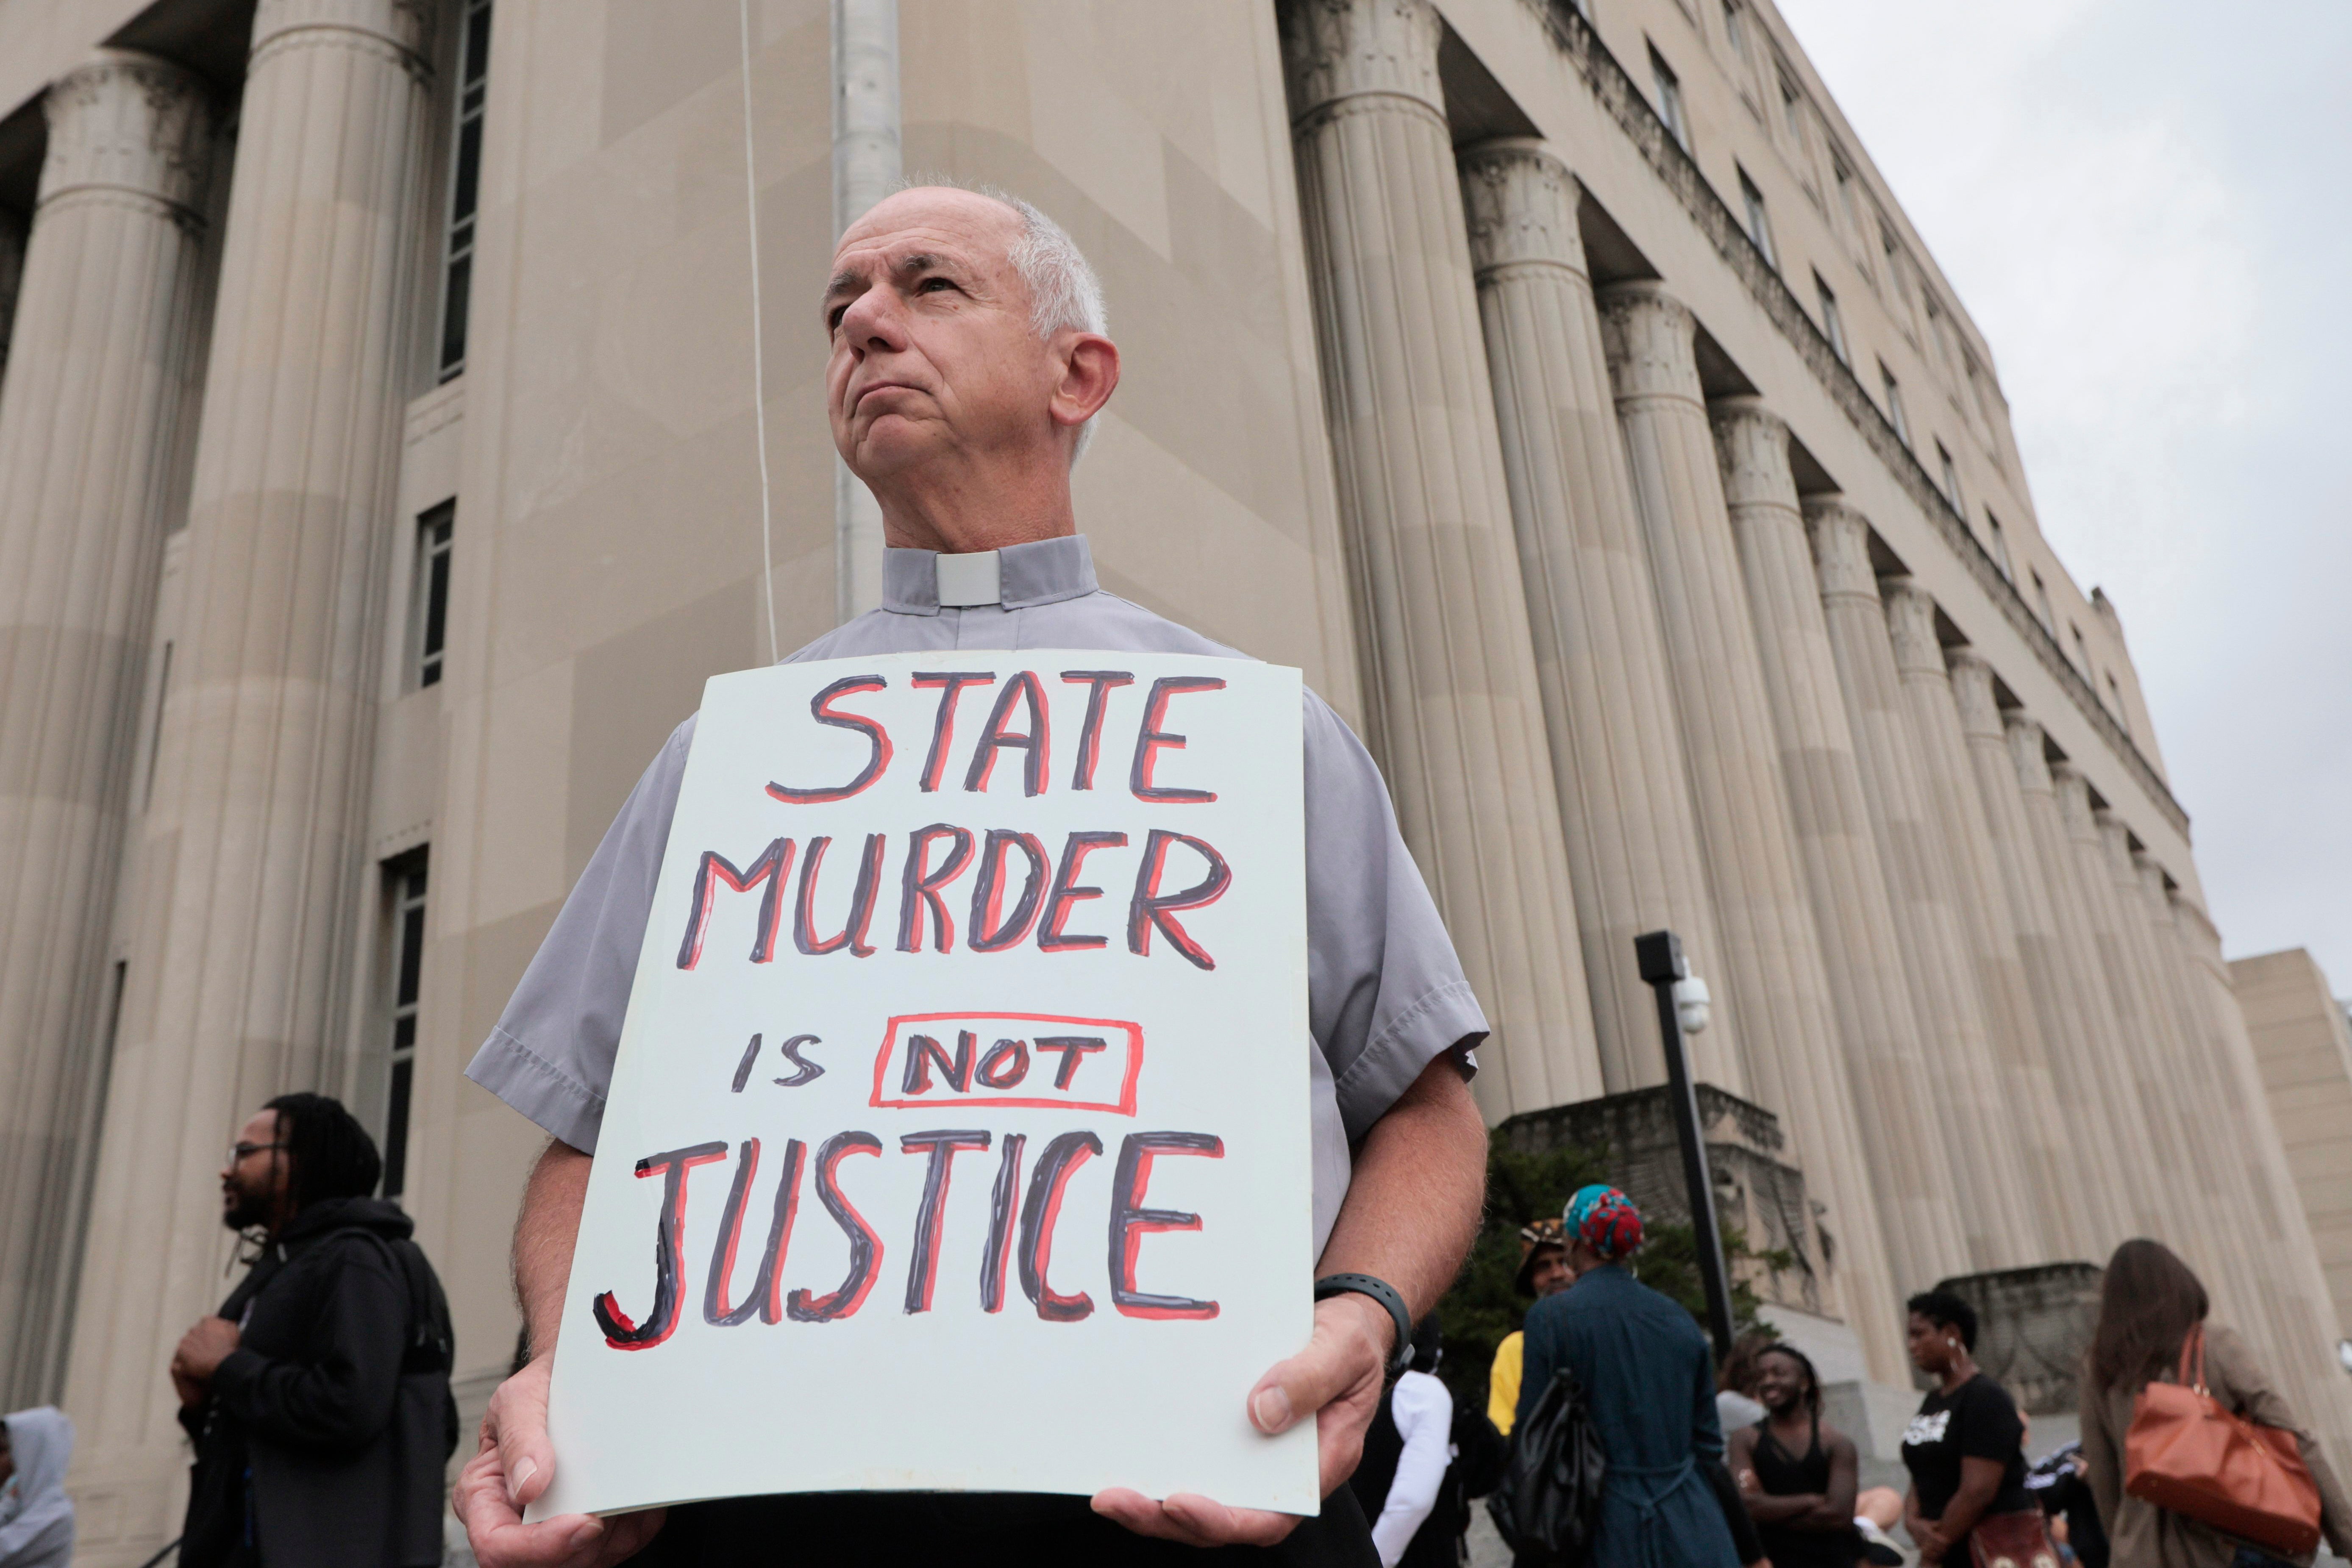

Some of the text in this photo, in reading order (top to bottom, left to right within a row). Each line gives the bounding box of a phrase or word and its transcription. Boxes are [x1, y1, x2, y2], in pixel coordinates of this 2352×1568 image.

[765, 670, 1226, 804] STATE
[676, 823, 1232, 970] MURDER
[731, 1030, 1107, 1095] IS NOT
[593, 1130, 1224, 1351] JUSTICE
